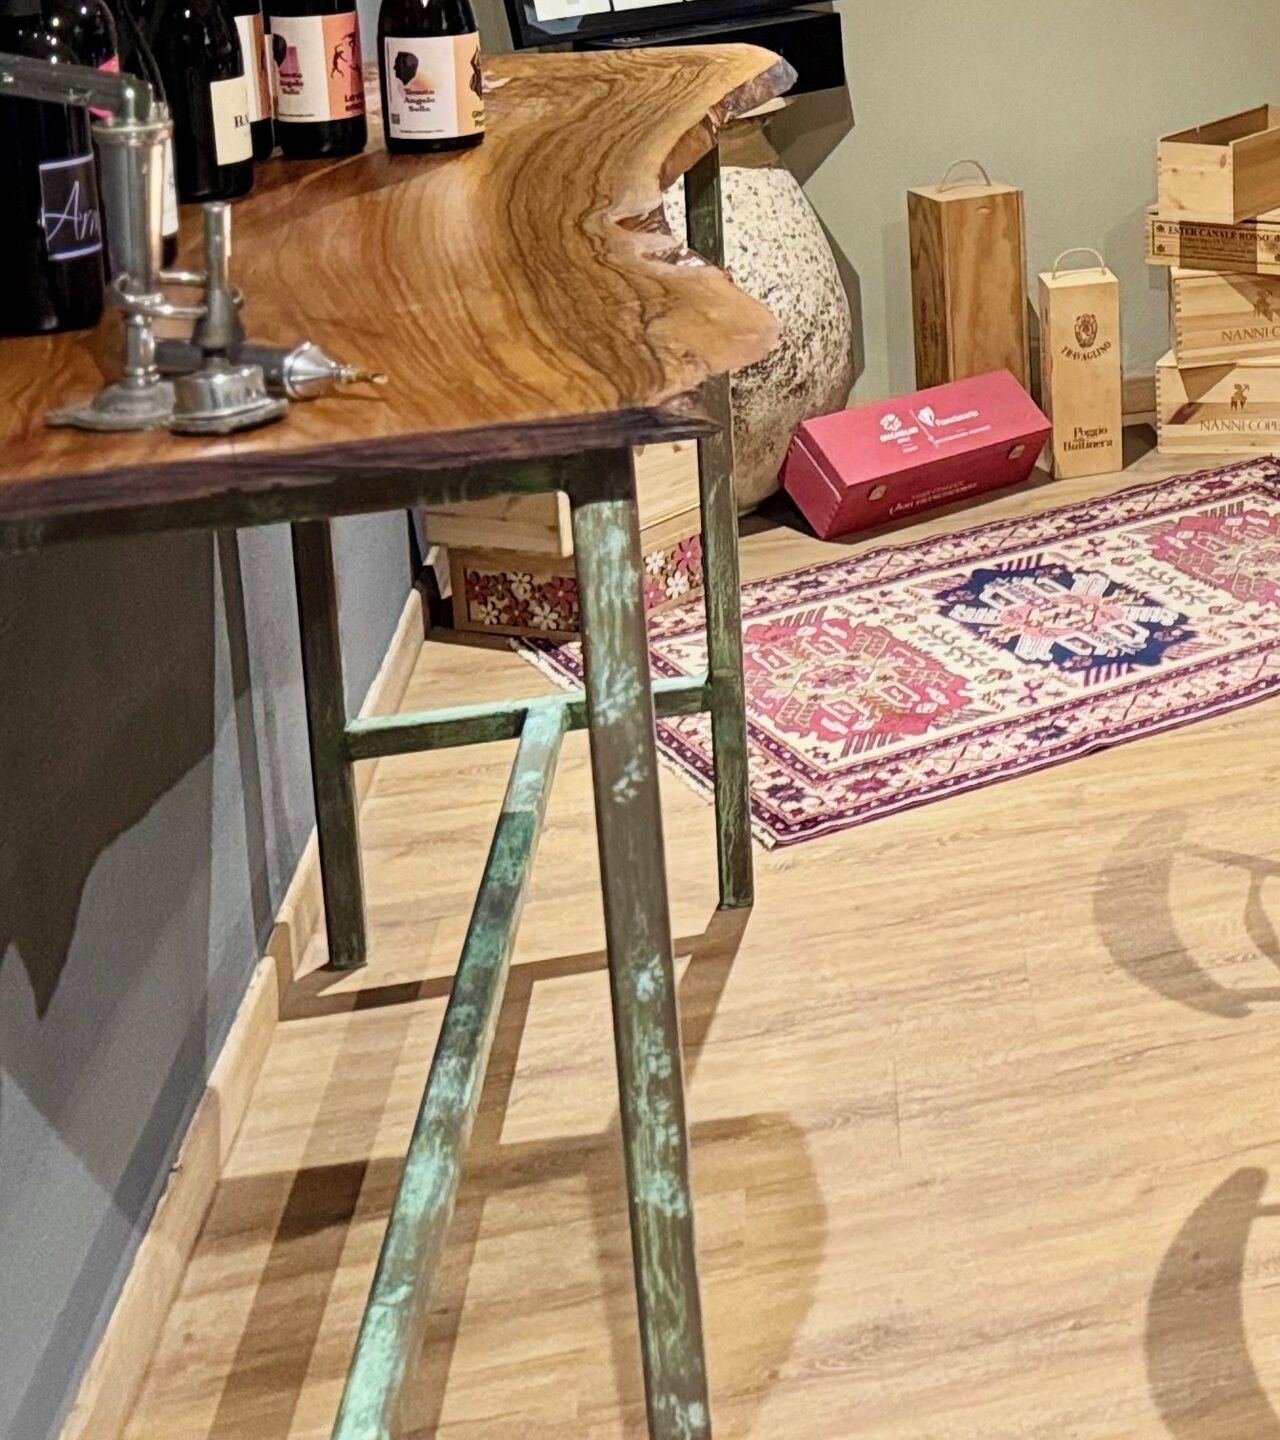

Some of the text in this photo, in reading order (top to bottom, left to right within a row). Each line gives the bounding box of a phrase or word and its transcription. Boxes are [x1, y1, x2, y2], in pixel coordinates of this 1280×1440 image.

[1167, 226, 1271, 242] ESTER CANALE ROSSO
[1222, 327, 1268, 343] NANNI
[1061, 341, 1112, 361] TRAVAGLINO
[1200, 419, 1245, 432] NANNI
